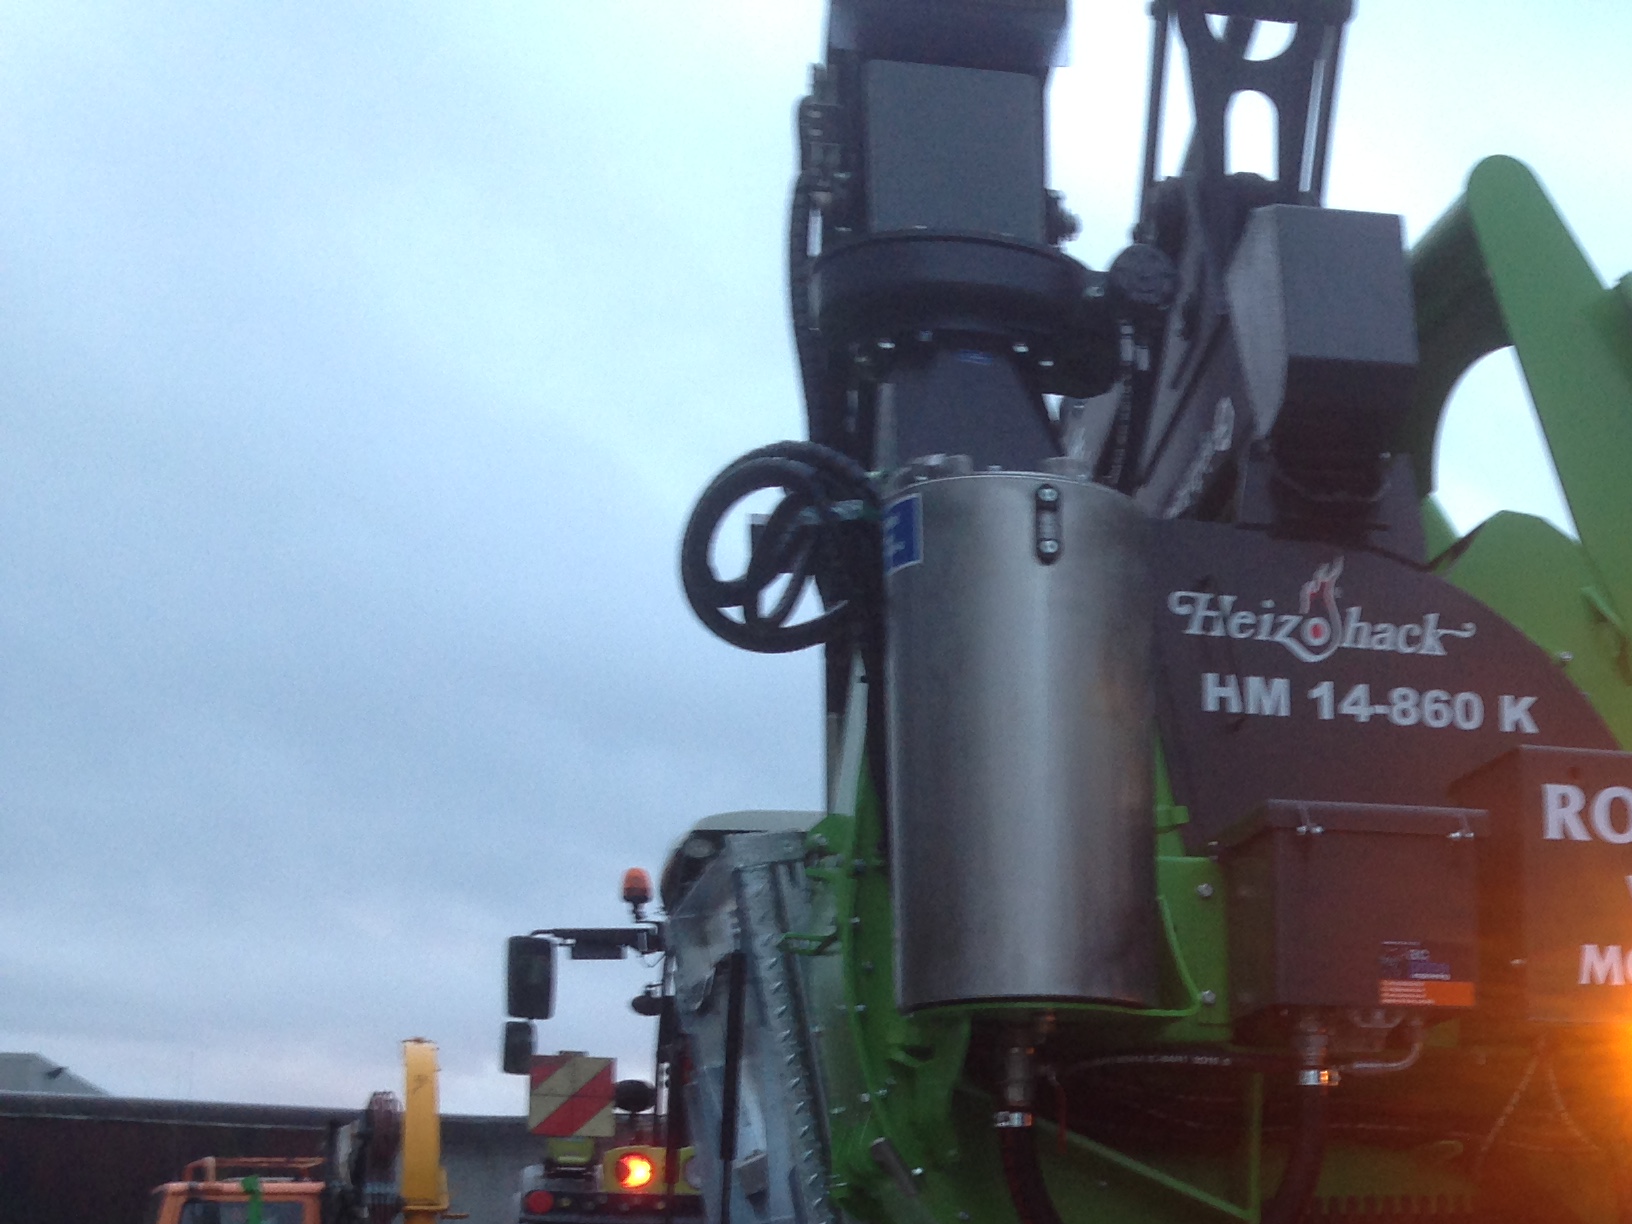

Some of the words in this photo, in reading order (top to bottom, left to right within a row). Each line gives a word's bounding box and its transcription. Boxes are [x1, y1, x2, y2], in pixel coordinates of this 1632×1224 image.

[1201, 672, 1292, 717] HM
[1307, 680, 1486, 731] 14-860
[1498, 694, 1540, 734] K
